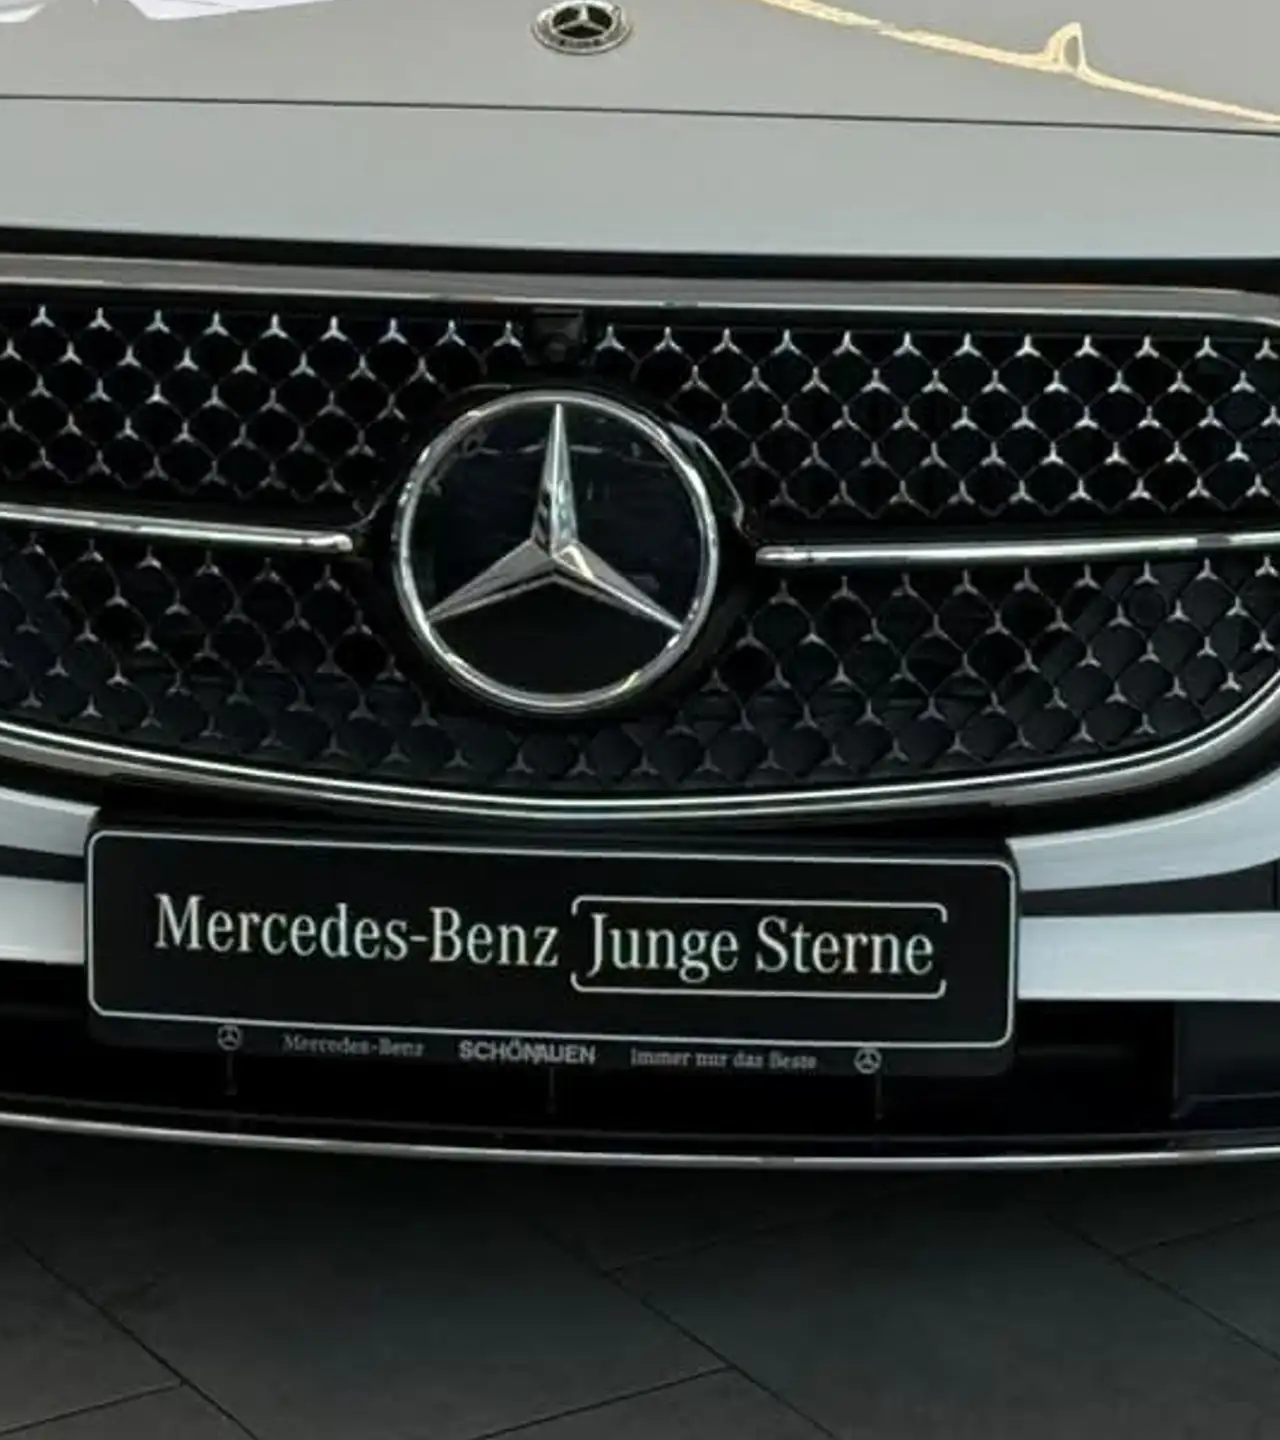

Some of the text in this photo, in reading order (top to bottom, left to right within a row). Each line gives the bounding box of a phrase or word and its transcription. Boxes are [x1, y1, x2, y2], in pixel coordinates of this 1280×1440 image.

[153, 892, 935, 984] Mercedes-Benz Junge Sterne
[458, 1037, 597, 1065] SCHÖNAUEN
